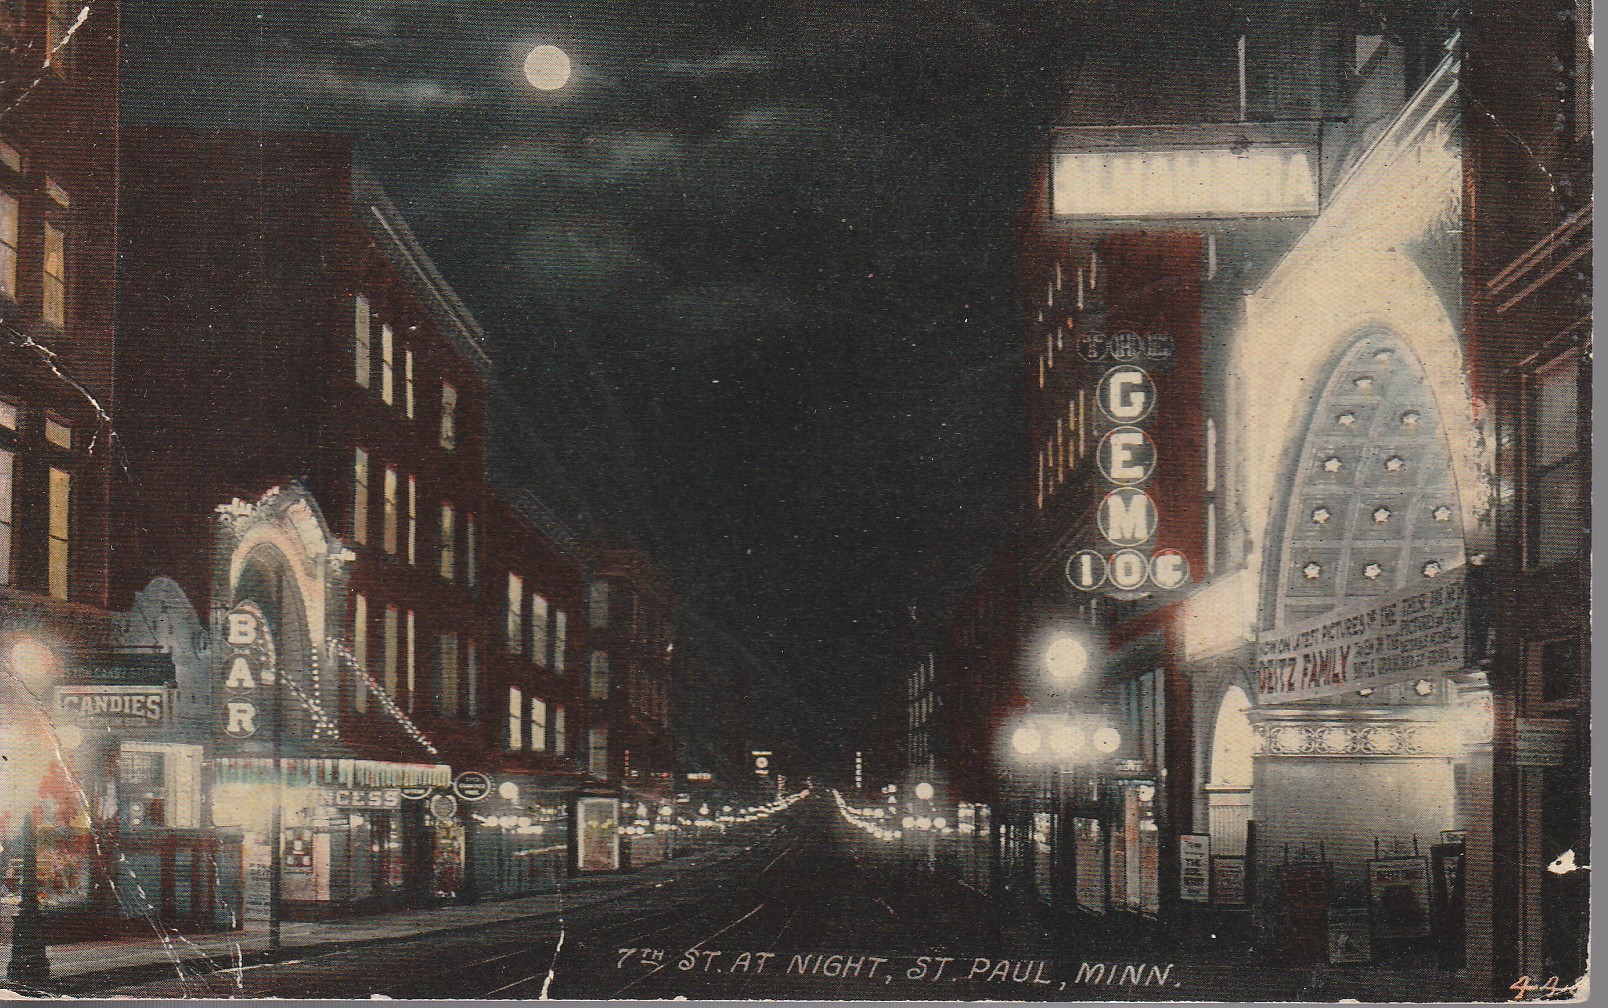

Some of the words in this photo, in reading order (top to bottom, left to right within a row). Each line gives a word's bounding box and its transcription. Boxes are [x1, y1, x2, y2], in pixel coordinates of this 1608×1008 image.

[1107, 371, 1149, 541] GEM
[62, 694, 162, 721] CANDIES
[225, 613, 258, 733] BAR
[1301, 644, 1351, 691] FAMILY
